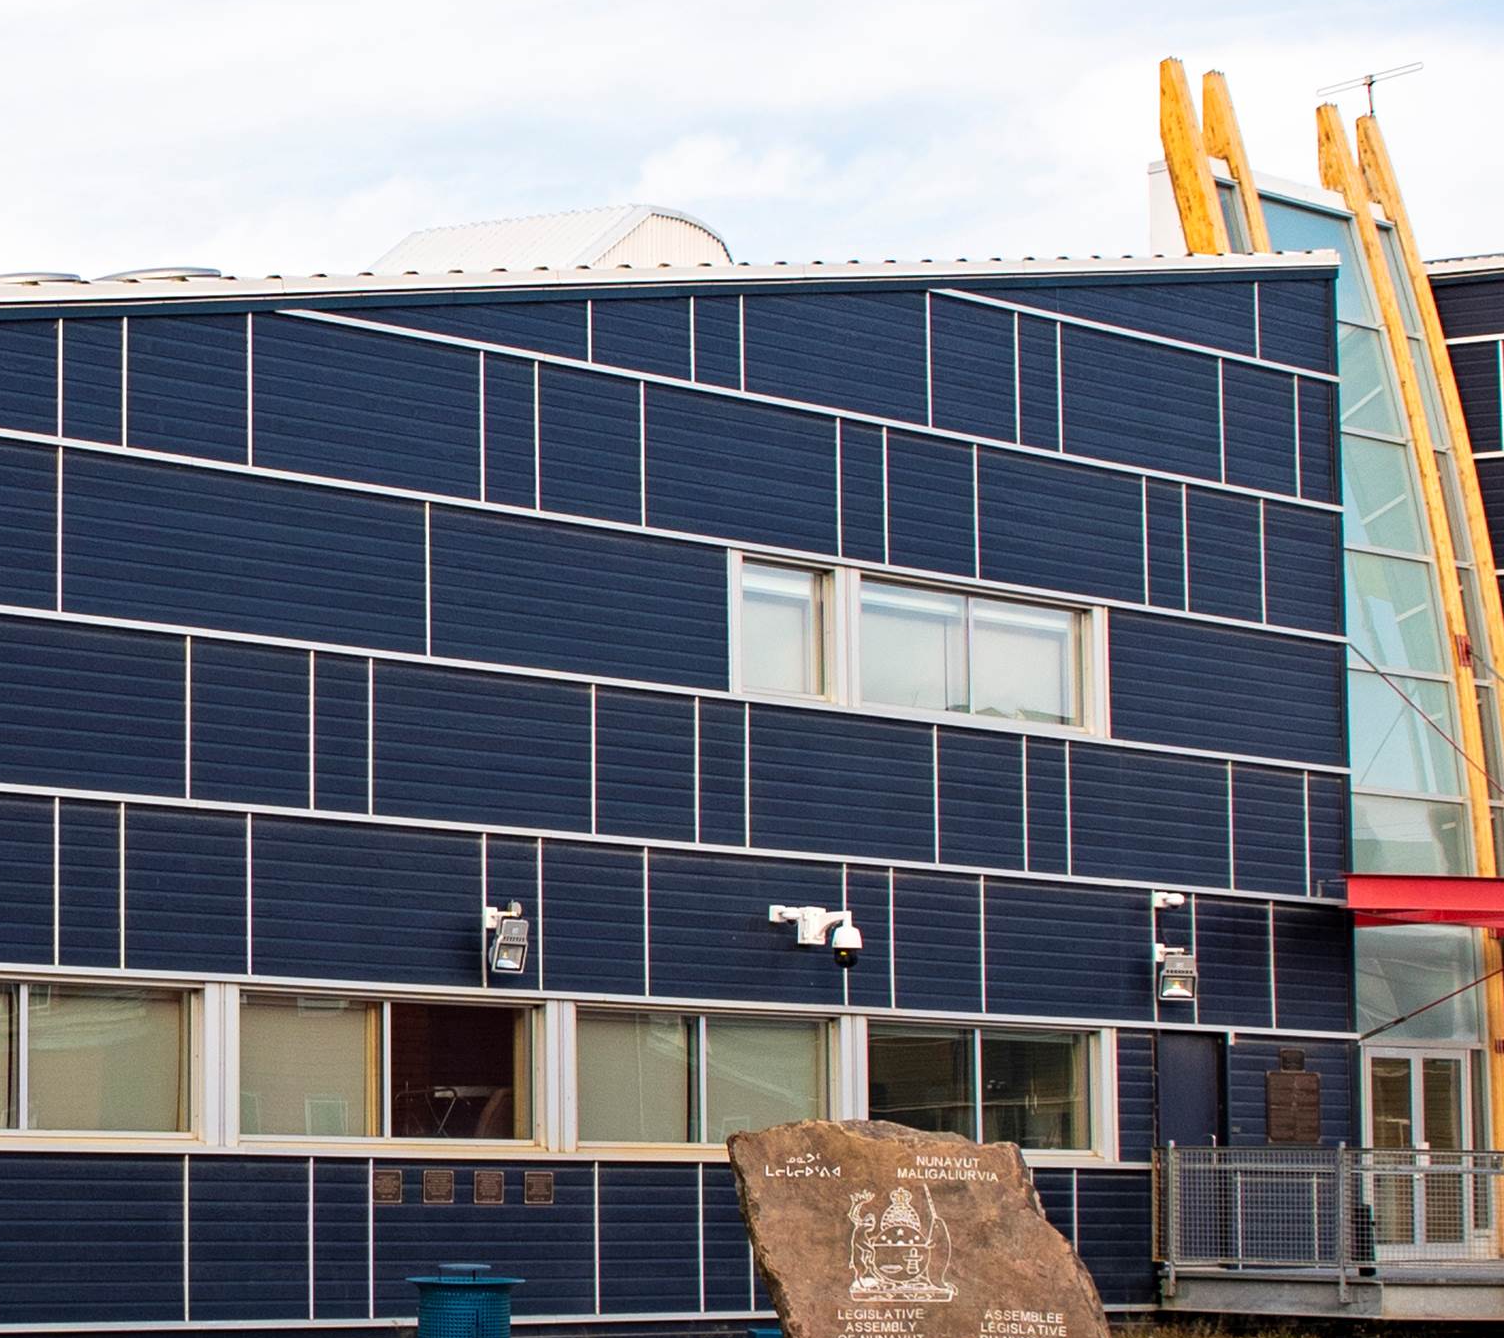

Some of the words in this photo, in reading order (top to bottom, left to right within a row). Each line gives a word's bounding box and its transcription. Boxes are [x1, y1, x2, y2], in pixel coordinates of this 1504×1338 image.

[916, 1155, 980, 1169] NUNAVUT
[897, 1167, 999, 1182] MALIGALIURVIA
[837, 1308, 925, 1320] LEGISLATIVE
[845, 1321, 917, 1333] ASSEMBLY
